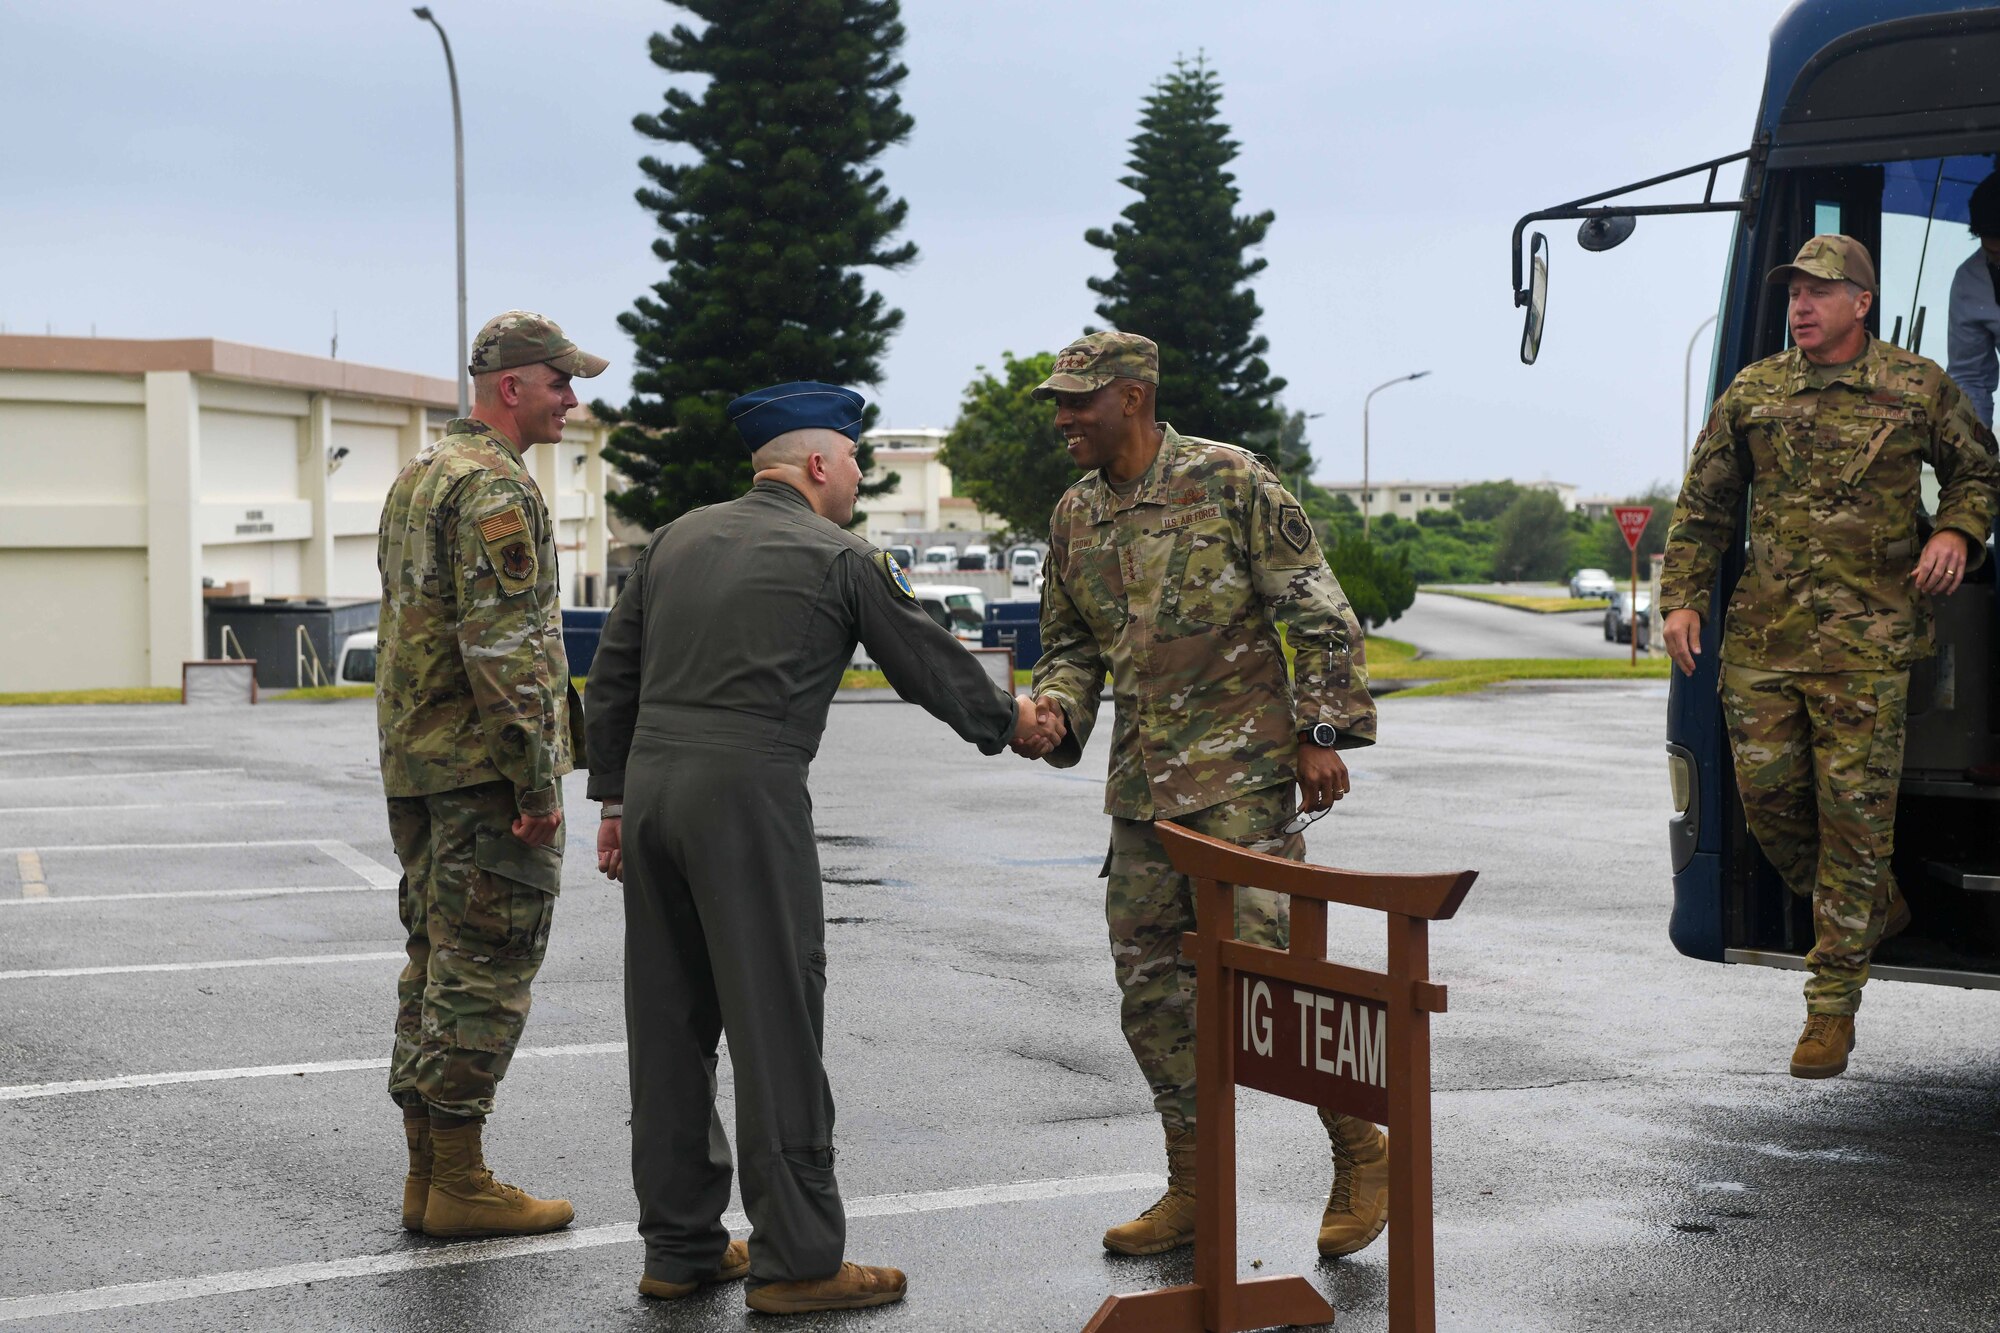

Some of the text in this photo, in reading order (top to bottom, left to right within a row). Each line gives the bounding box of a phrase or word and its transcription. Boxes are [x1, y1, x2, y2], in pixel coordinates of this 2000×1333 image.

[1164, 507, 1219, 529] U.S. AIR FORCE
[1621, 512, 1645, 526] STOP
[1071, 537, 1093, 551] BROWN
[1243, 977, 1386, 1089] IG TEAM
